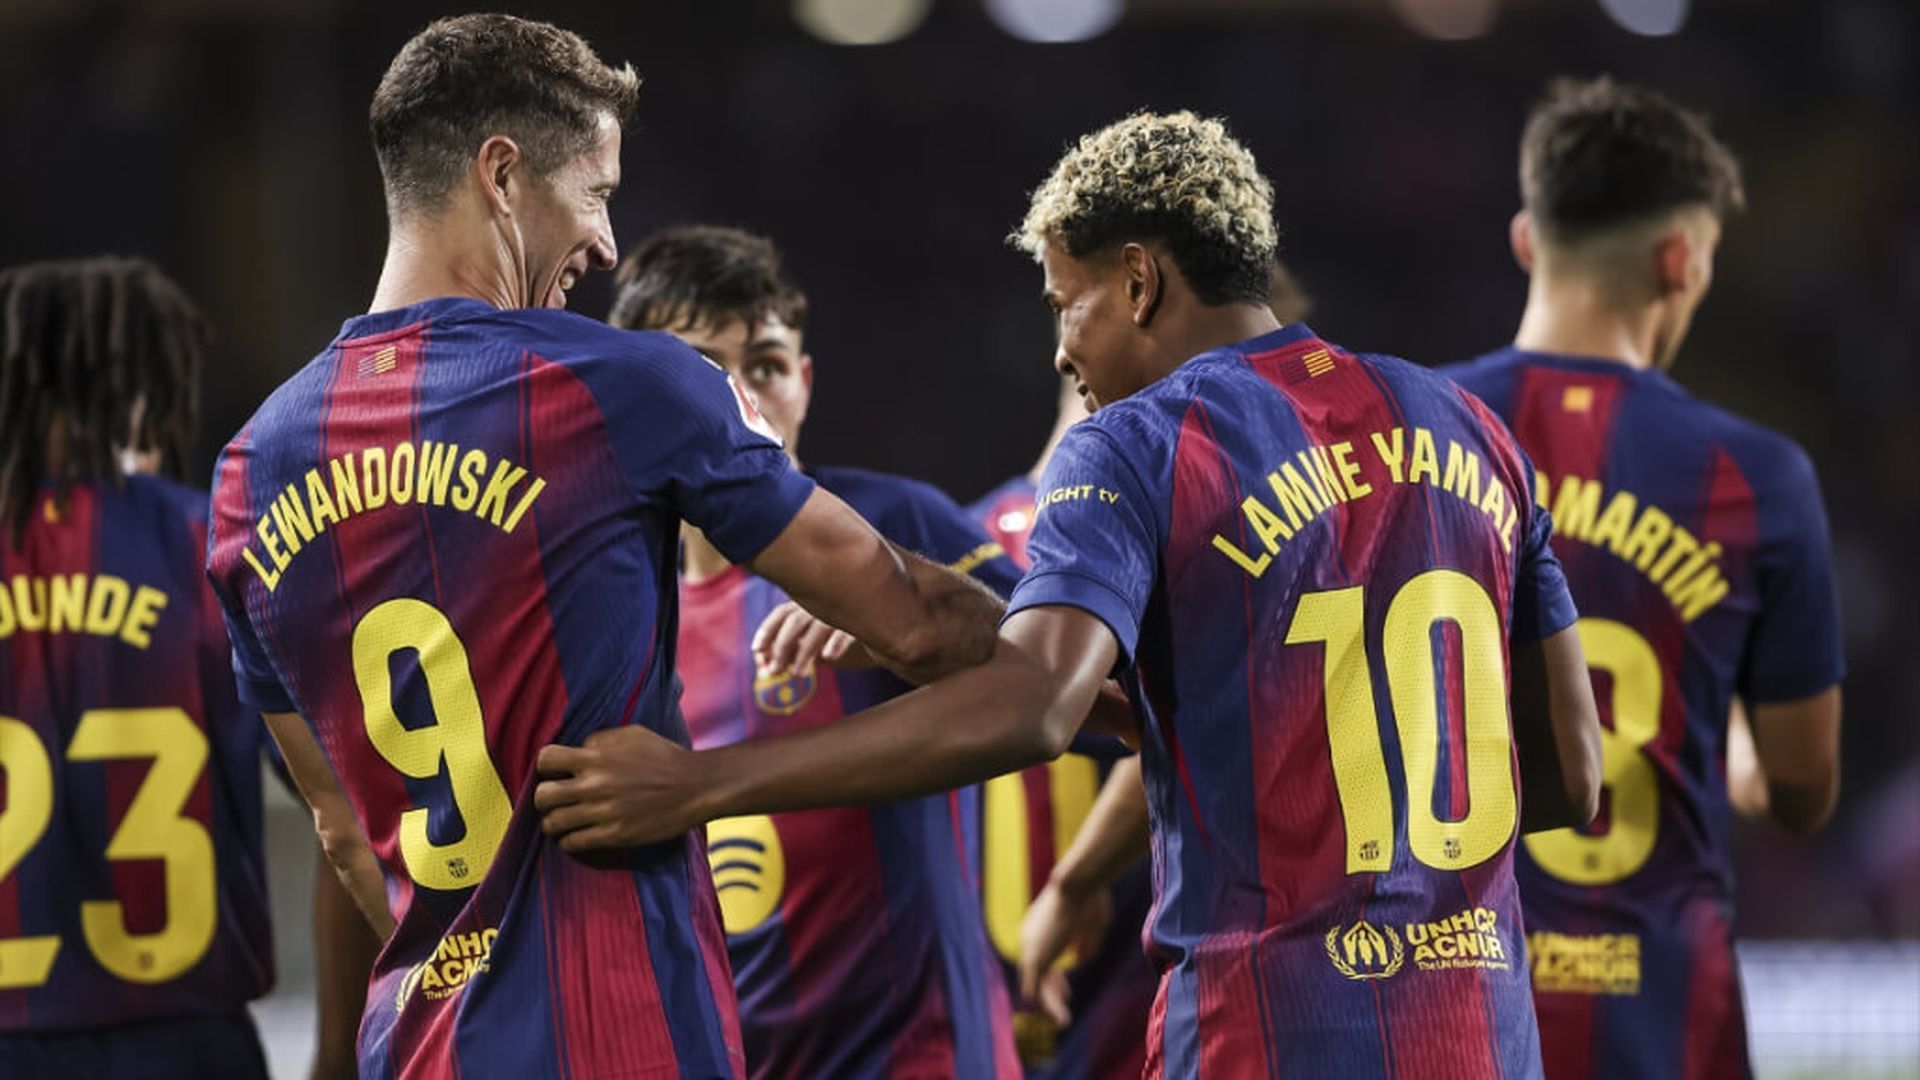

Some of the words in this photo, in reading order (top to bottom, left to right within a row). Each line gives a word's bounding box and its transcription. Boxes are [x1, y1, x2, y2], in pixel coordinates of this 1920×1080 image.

[242, 440, 547, 593] LEWANDOWSKI
[1212, 441, 1373, 578] LAMINE
[1370, 427, 1517, 555] YAMAL
[352, 598, 513, 890] 9
[1284, 569, 1517, 875] 10
[430, 927, 499, 961] NHC
[1406, 906, 1497, 946] UNHCR
[1414, 932, 1505, 961] ACNUR
